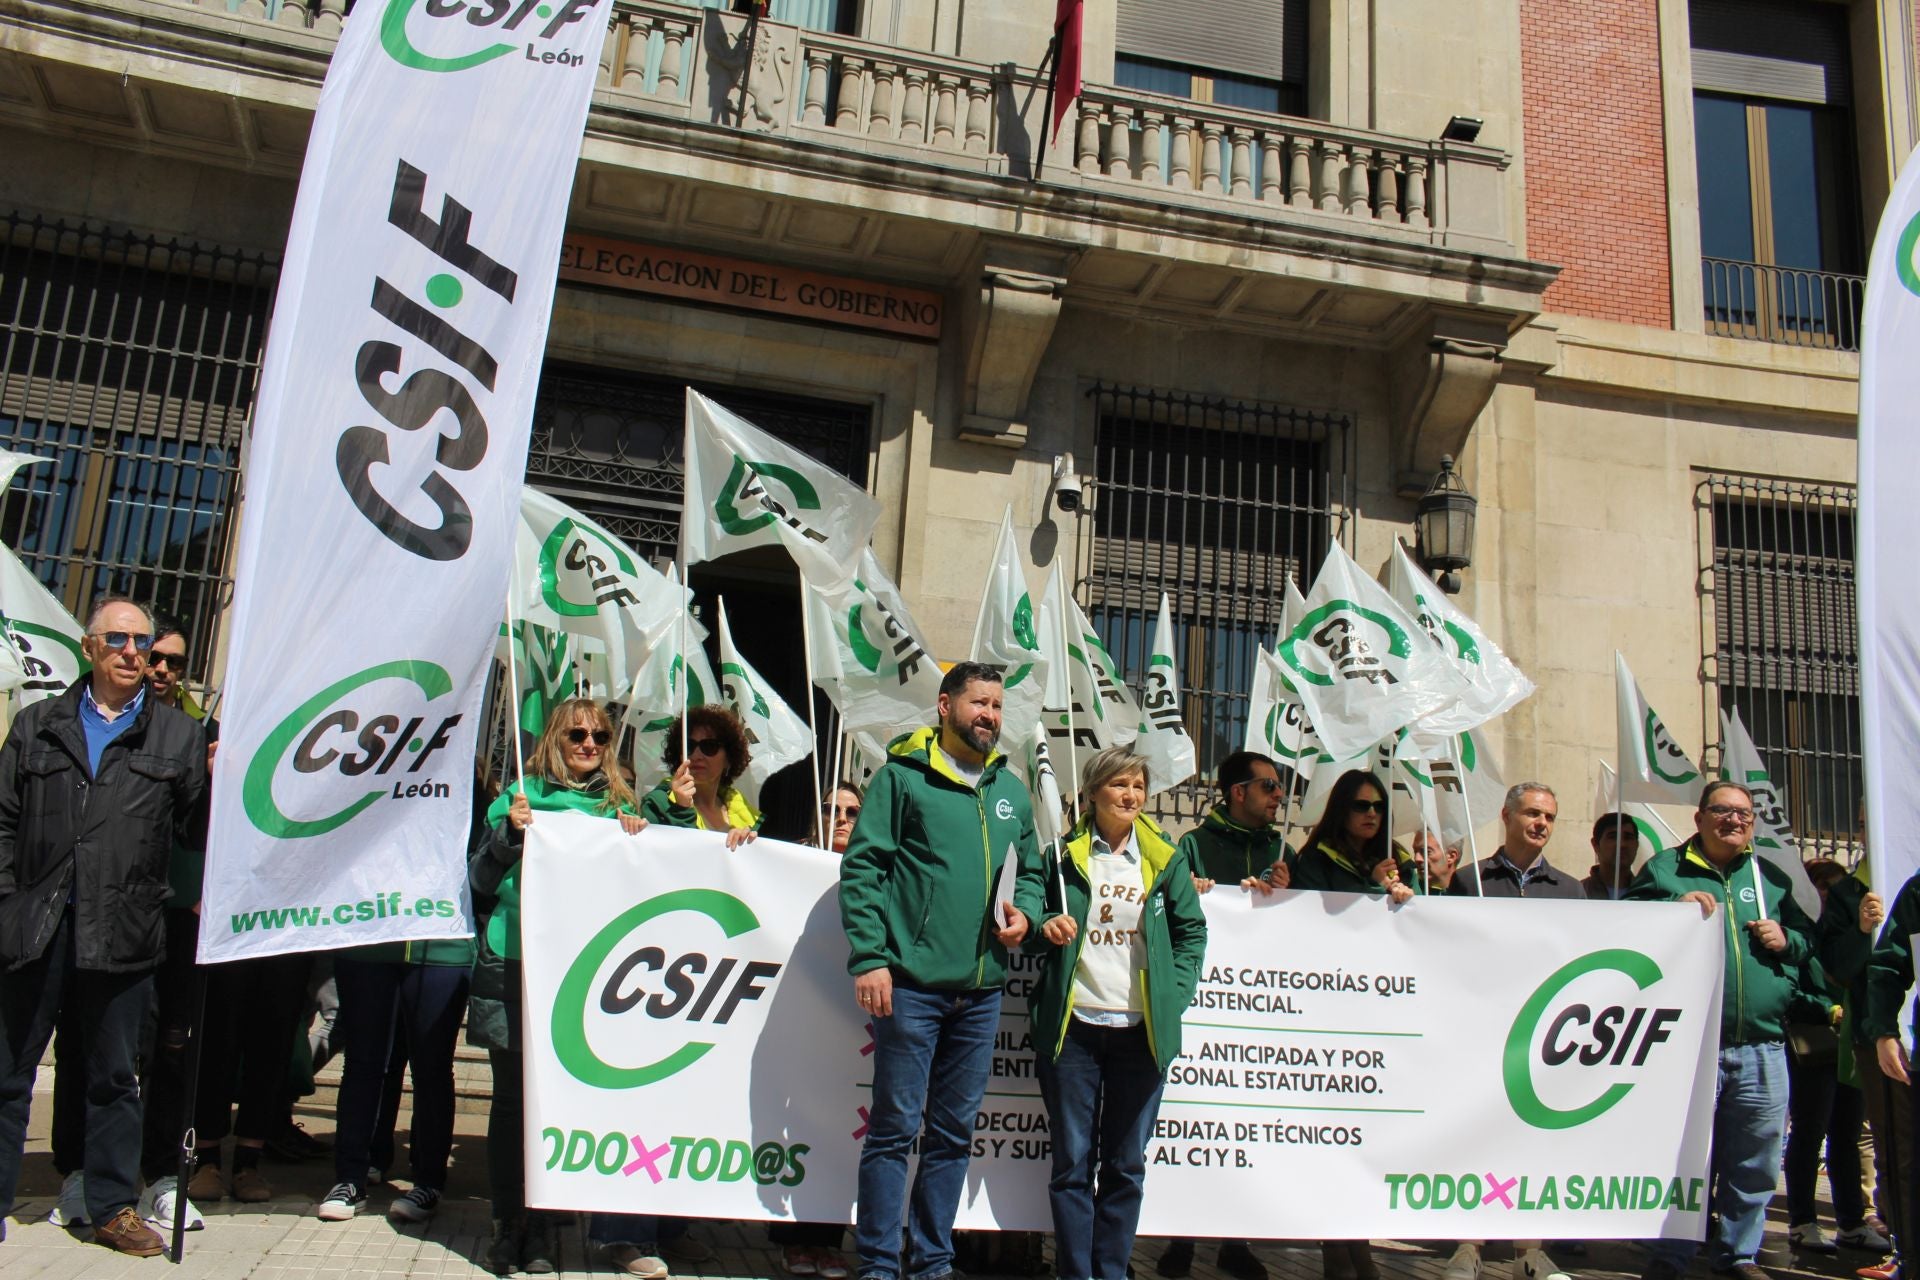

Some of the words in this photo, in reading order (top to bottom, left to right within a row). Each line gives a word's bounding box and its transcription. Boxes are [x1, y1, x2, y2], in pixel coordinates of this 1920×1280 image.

[525, 42, 584, 67] León
[559, 243, 722, 292] ELEGACION
[729, 270, 787, 302] DEL
[798, 282, 939, 327] GOBIERNO
[1144, 672, 1185, 736] CSIF
[391, 777, 450, 800] León
[230, 892, 456, 934] www.csif.es
[1099, 903, 1114, 924] &
[1089, 929, 1139, 946] OAST
[599, 946, 783, 1025] CSIF
[1239, 968, 1369, 993] CATEGORÍAS
[1374, 975, 1417, 997] QUE
[1541, 1003, 1683, 1067] CSIF
[1199, 1042, 1319, 1067] ANTICIPADA
[1321, 1048, 1337, 1067] Y
[1342, 1049, 1386, 1070] POR
[1169, 1065, 1239, 1088] SONAL
[1245, 1070, 1384, 1095] ESTATUTARIO.
[1154, 1119, 1230, 1141] EDIATA
[1234, 1122, 1259, 1142] DE
[1262, 1118, 1363, 1147] TÉCNICOS
[992, 1138, 1007, 1158] Y
[1153, 1145, 1181, 1166] AL
[1235, 1149, 1254, 1168] B.
